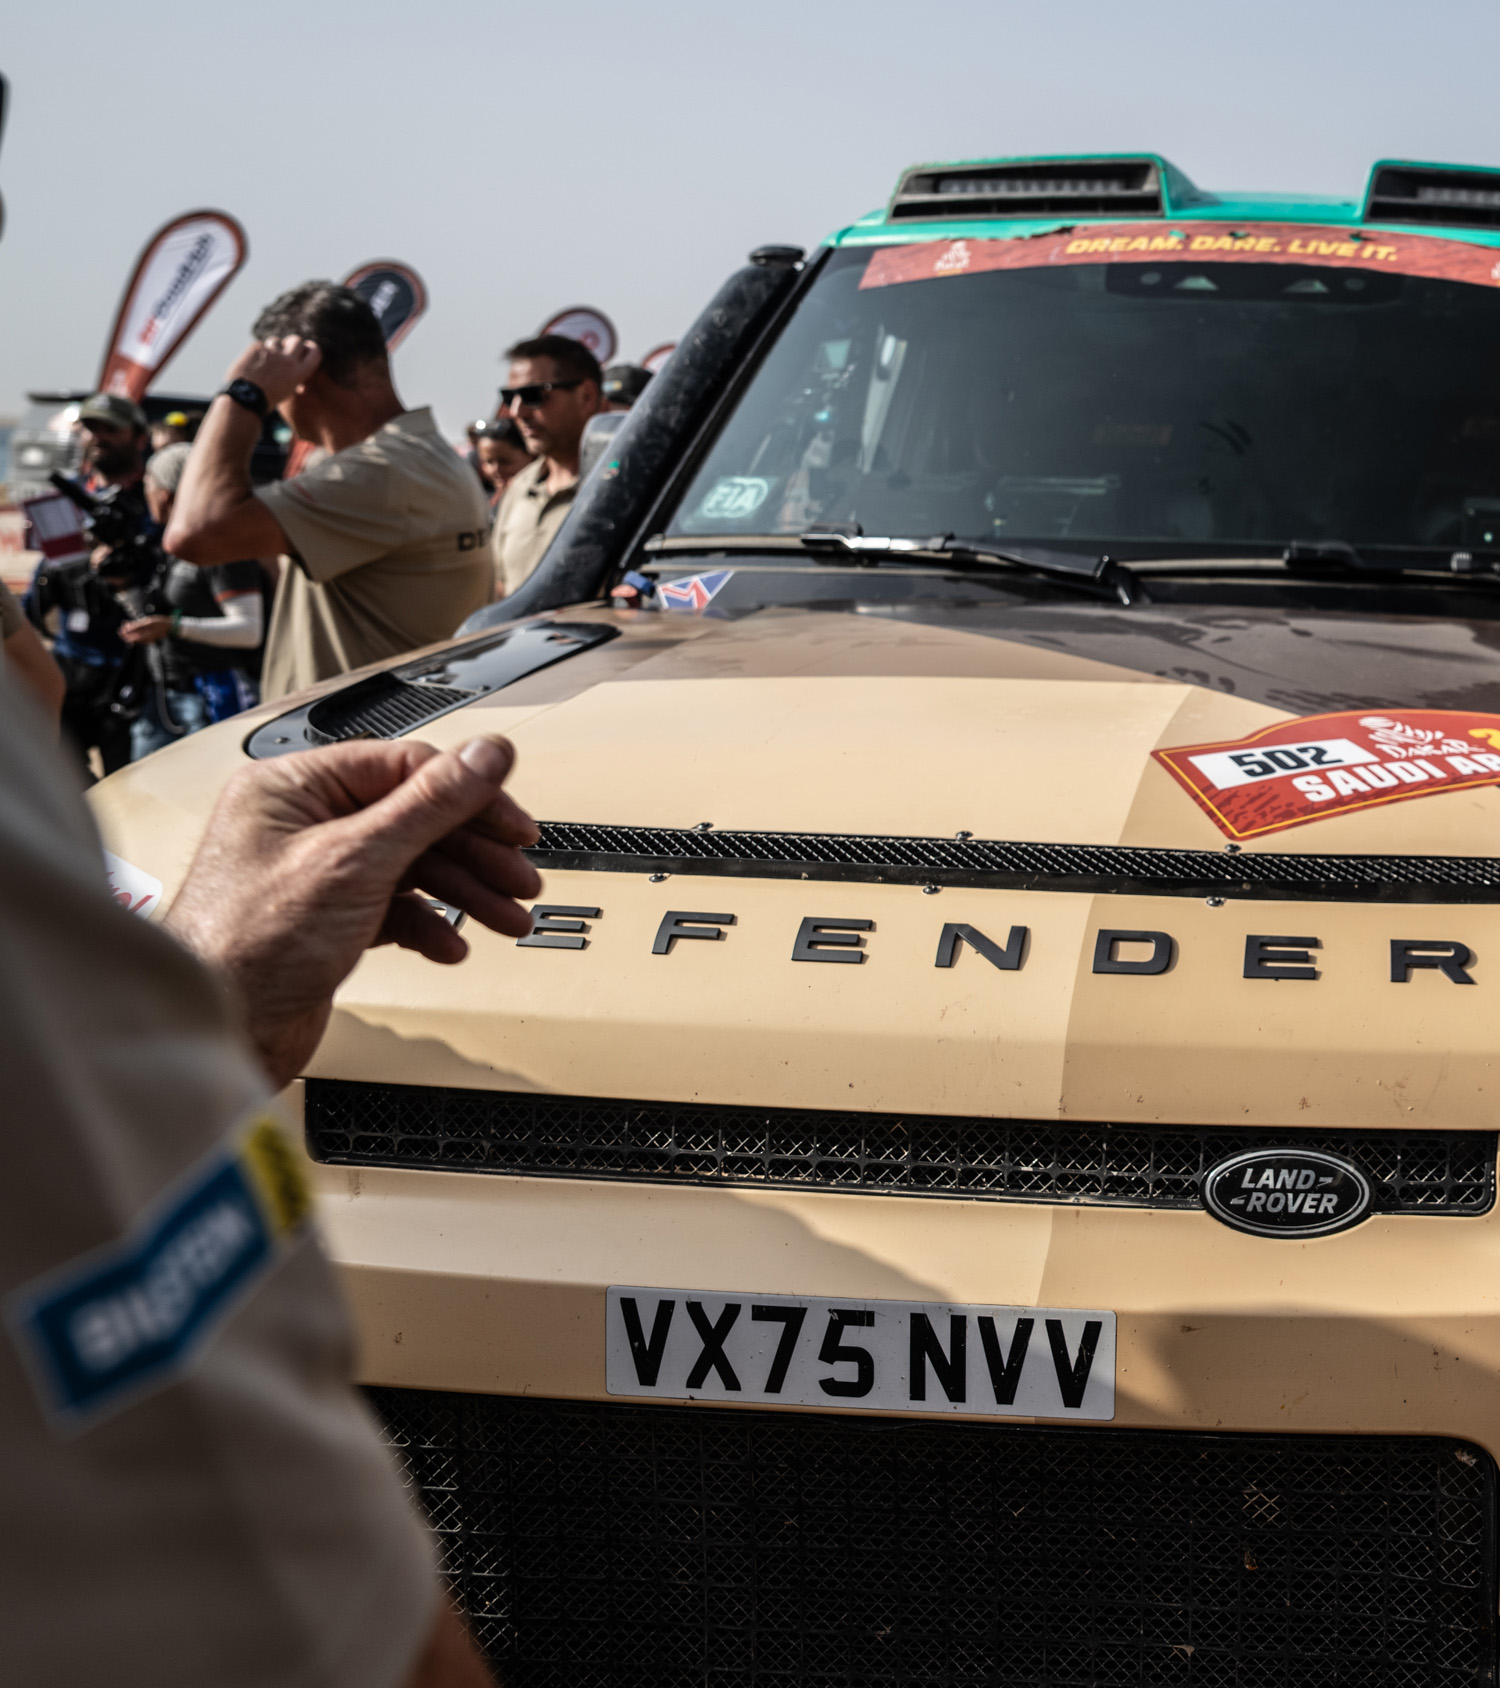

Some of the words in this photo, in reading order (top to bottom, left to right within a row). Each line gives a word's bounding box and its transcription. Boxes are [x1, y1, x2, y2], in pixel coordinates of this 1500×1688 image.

[1065, 236, 1184, 254] DREAM.
[1190, 235, 1282, 253] DARE.
[1287, 239, 1356, 258] LIVE
[1360, 244, 1399, 262] IT.
[1228, 745, 1344, 778] 502
[1291, 757, 1448, 803] SAUDI
[1241, 1168, 1316, 1190] LAND
[1246, 1191, 1339, 1214] ROVER
[619, 1296, 875, 1399] VX75
[909, 1311, 1104, 1409] NVV
